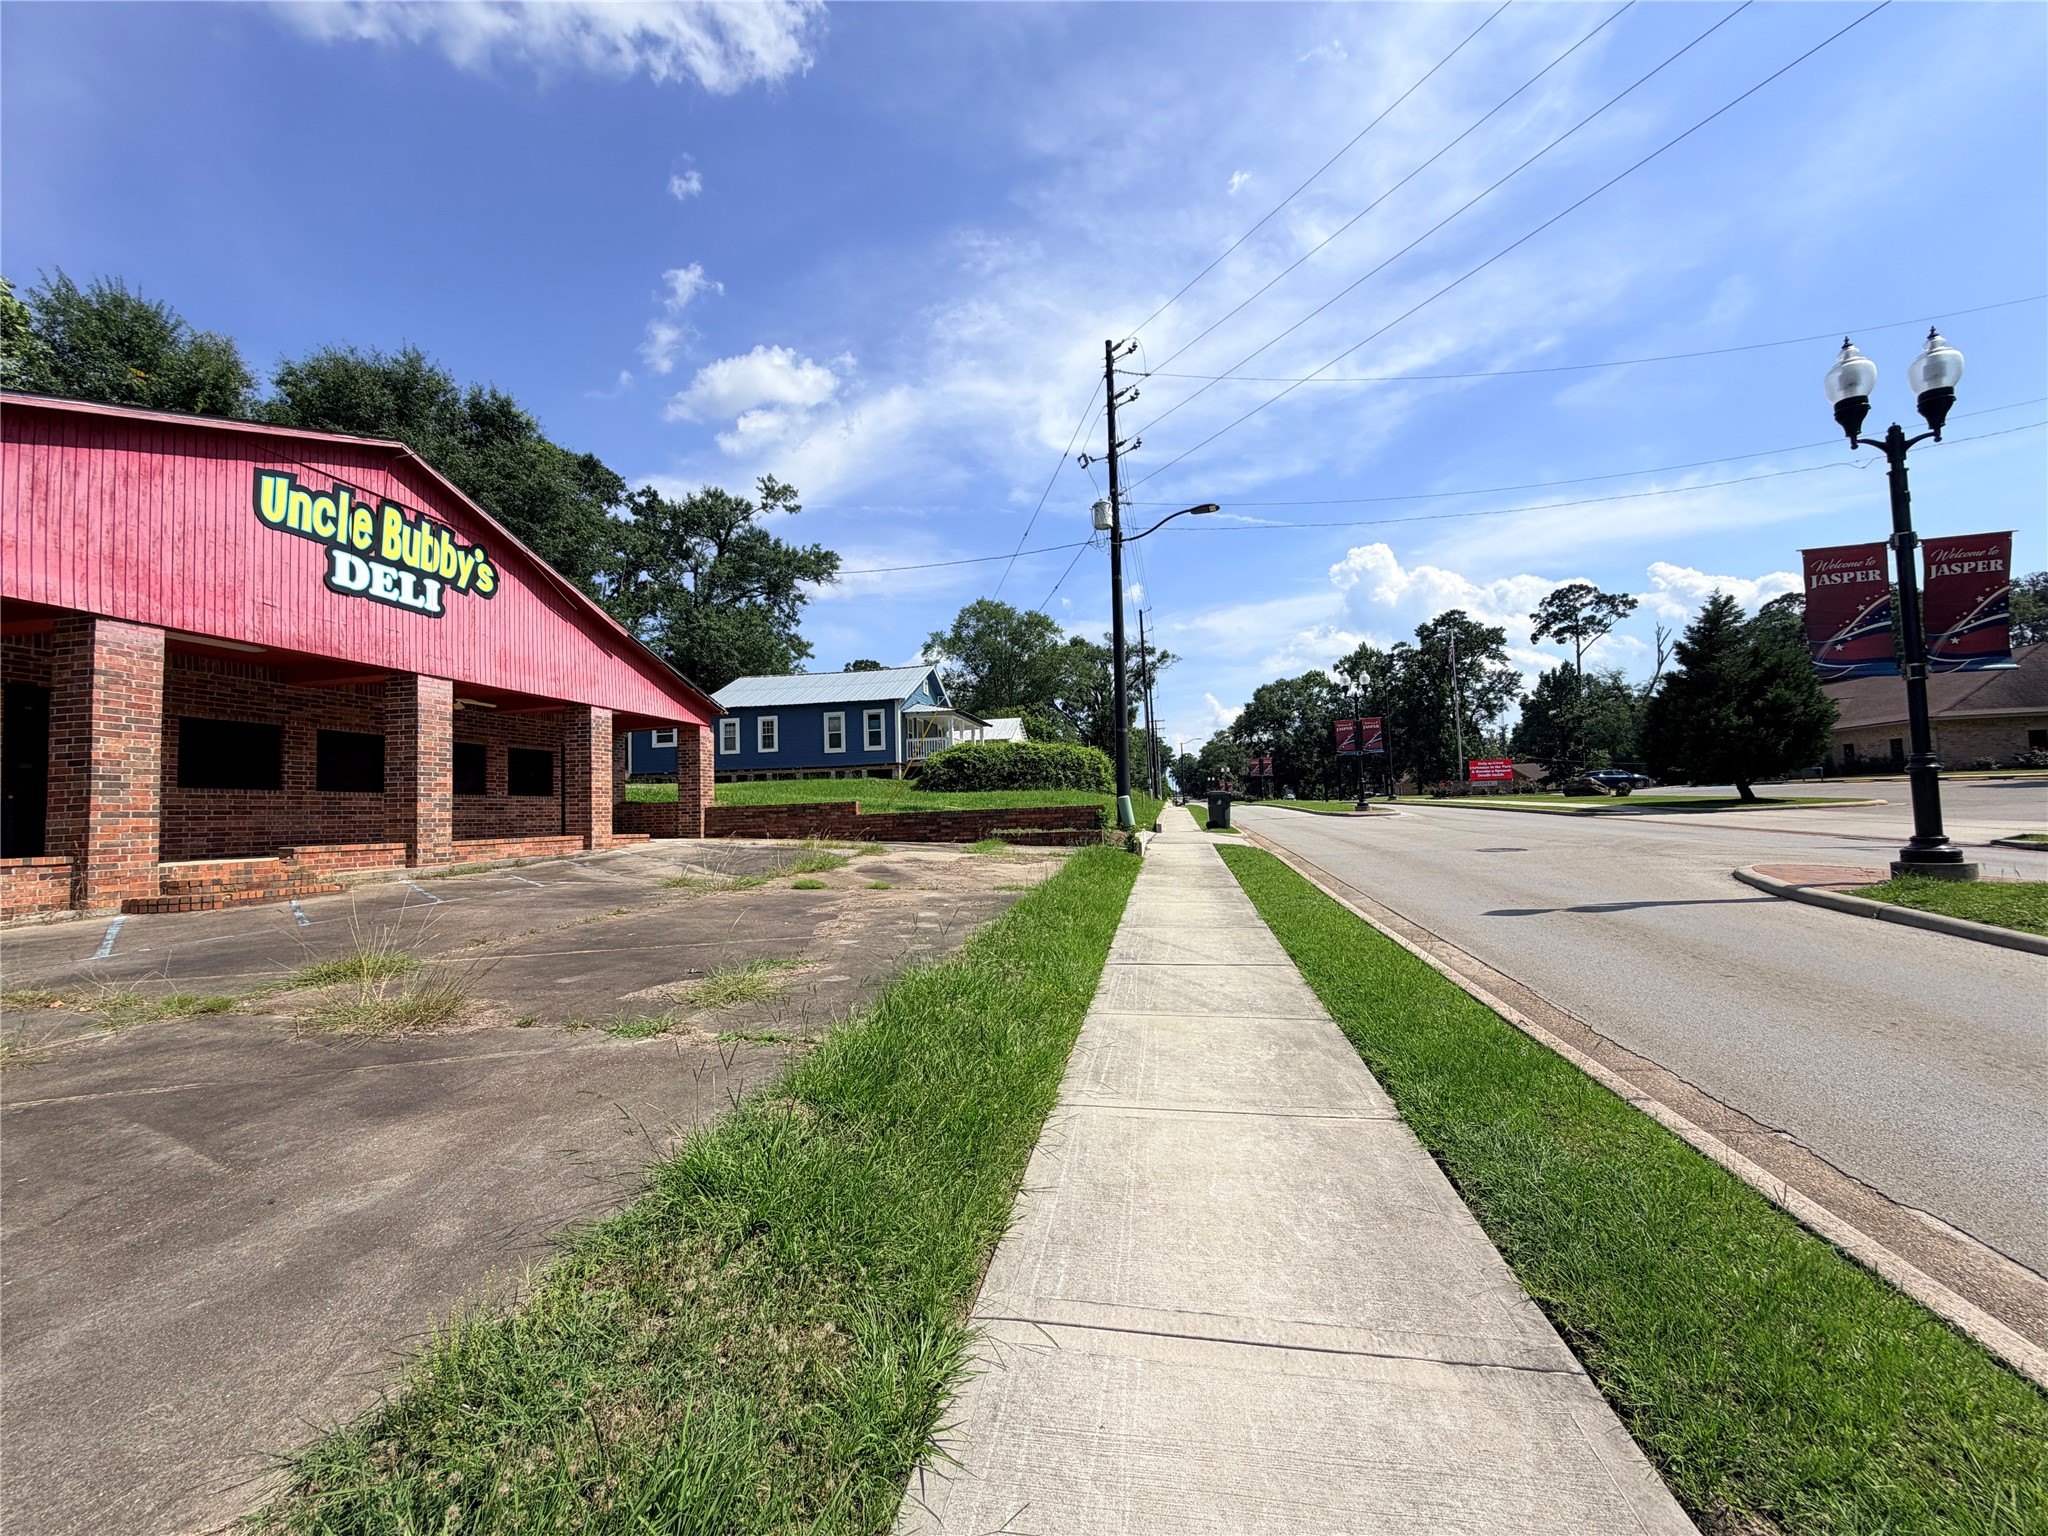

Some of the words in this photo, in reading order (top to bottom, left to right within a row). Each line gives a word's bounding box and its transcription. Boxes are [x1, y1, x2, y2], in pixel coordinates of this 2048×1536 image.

[260, 475, 374, 550] Uncle
[381, 504, 495, 593] Bubby's
[1930, 547, 1986, 562] Welcome
[1988, 545, 2000, 556] to
[1810, 558, 1863, 573] Welcome
[1865, 556, 1877, 566] to
[1929, 558, 2005, 580] JASPER
[331, 549, 441, 613] DELI
[1809, 569, 1882, 590] JASPER
